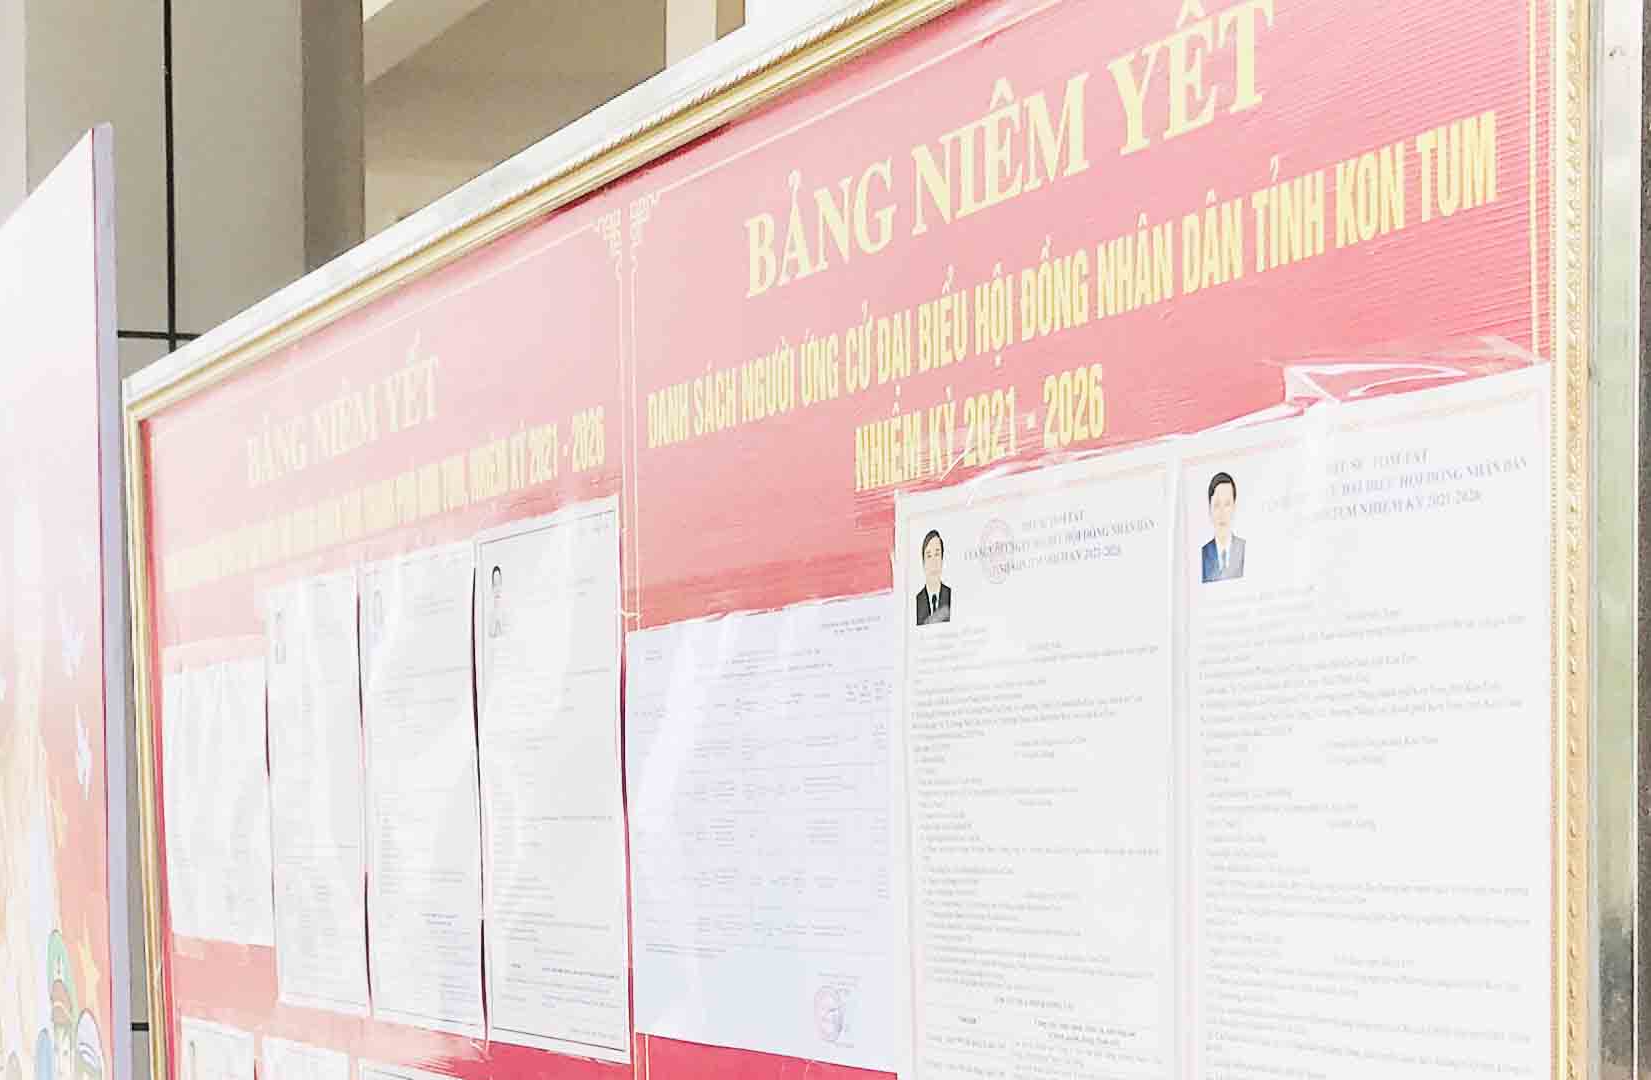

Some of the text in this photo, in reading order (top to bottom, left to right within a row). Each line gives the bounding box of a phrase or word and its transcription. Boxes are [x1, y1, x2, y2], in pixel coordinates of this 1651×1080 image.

[647, 384, 690, 448] DANH
[693, 361, 737, 436] SÁCH
[741, 335, 796, 422] NGƯỜI
[845, 299, 875, 394] CỬ
[918, 264, 968, 375] BIỂU
[974, 262, 1014, 367] HỘI
[1021, 234, 1090, 342] ĐỒNG
[1096, 212, 1174, 320] NHÂN
[1181, 189, 1244, 295] DÂN
[1252, 154, 1326, 273] TỈNH
[1335, 141, 1405, 249] KON
[1415, 110, 1497, 224] TUM
[745, 168, 898, 298] BẢNG
[911, 76, 1090, 238] NIÊM
[854, 403, 922, 492] NHIỆM
[962, 384, 1017, 467] 2021
[1043, 363, 1103, 449] 2026
